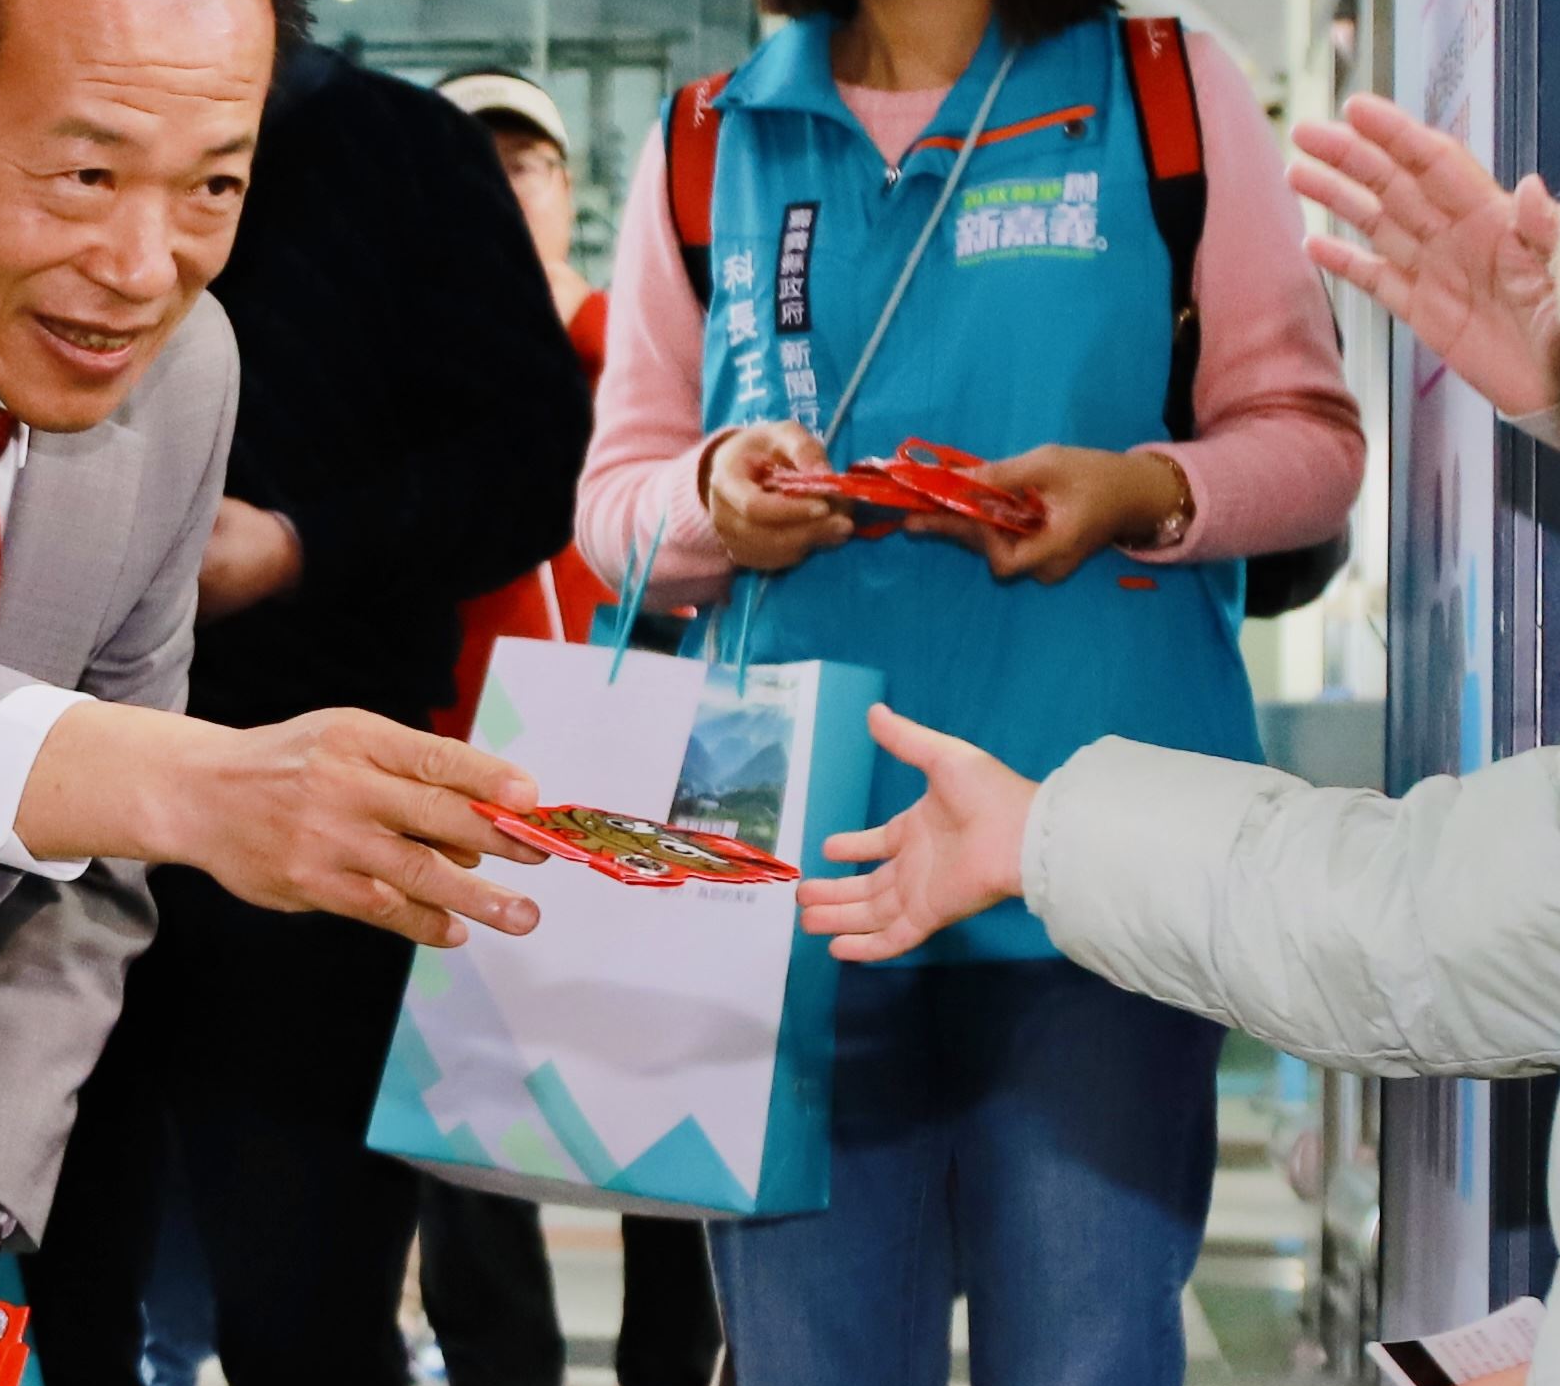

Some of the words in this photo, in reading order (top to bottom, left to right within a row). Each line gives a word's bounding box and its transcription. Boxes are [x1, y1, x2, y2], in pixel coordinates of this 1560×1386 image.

[723, 247, 768, 431] 科長王
[780, 340, 824, 445] 新聞行
